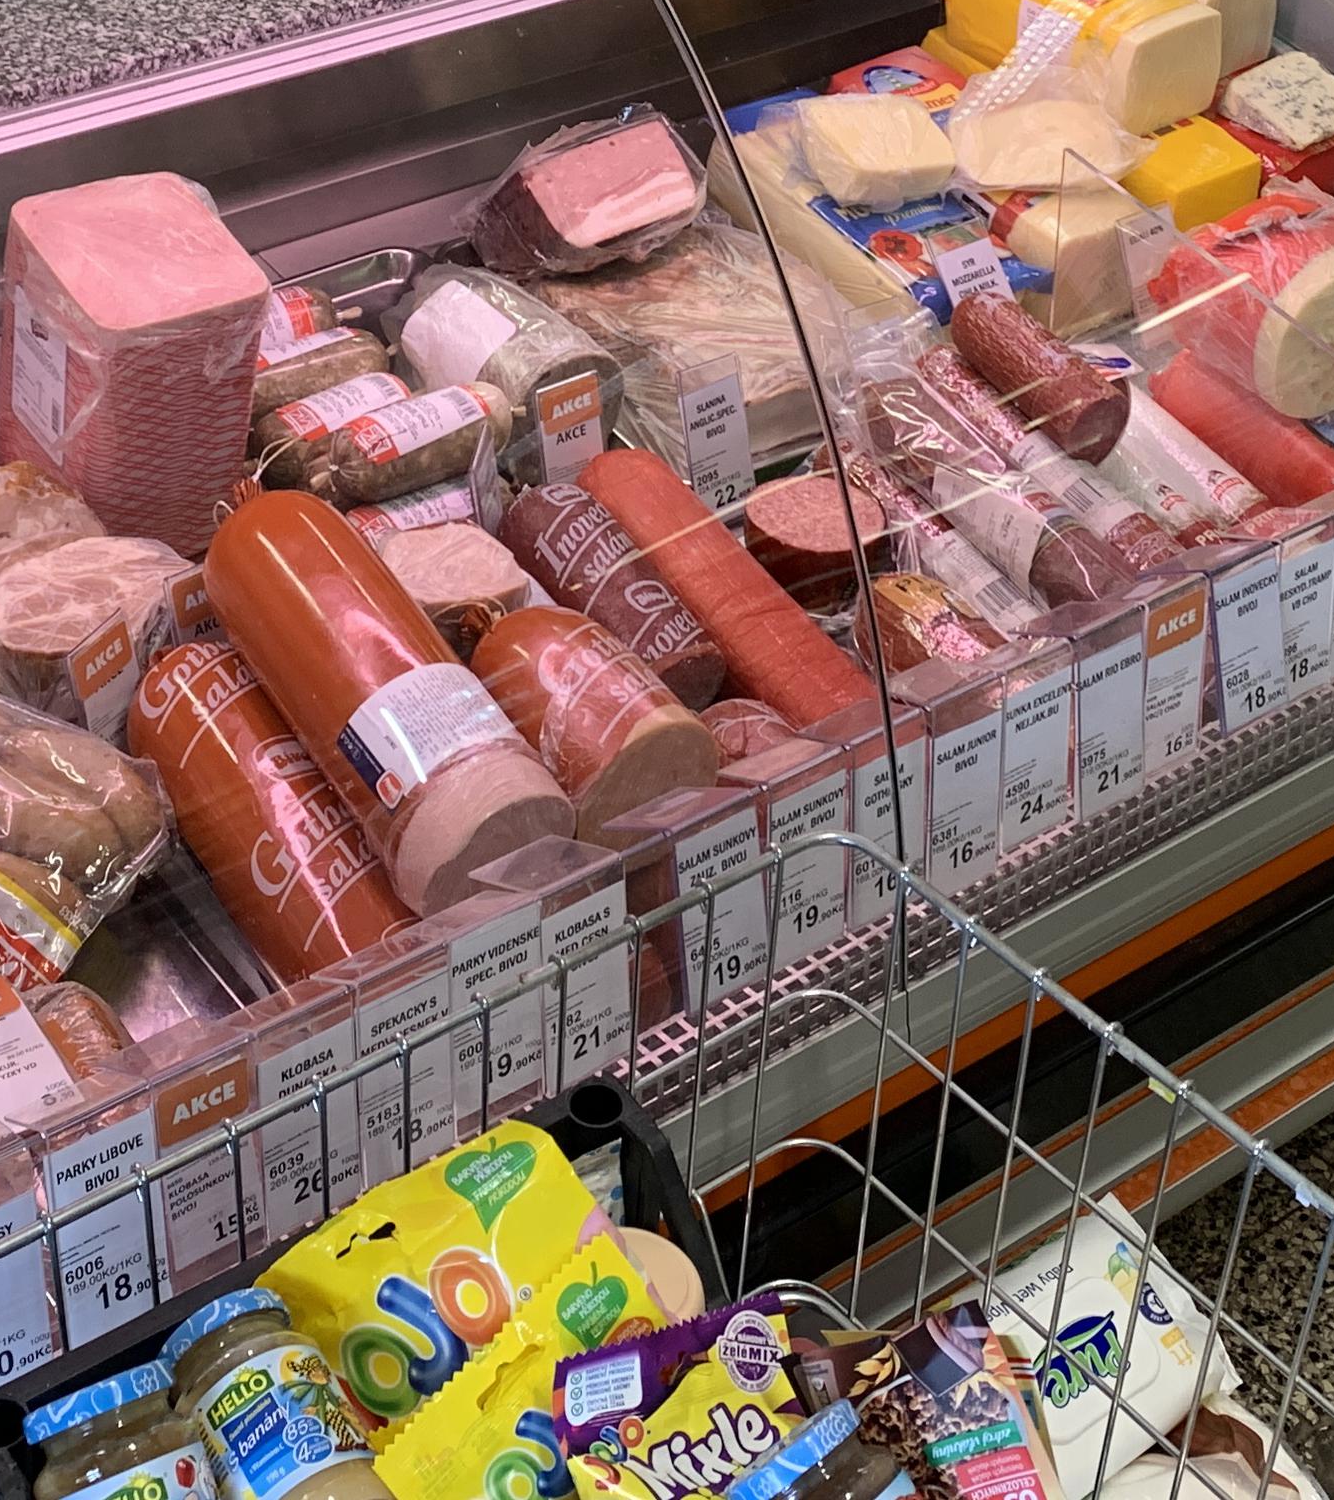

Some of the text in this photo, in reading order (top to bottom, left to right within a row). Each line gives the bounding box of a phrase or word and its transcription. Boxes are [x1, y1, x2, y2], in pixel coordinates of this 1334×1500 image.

[951, 263, 996, 289] MOZZARELLA
[551, 391, 592, 421] AKCE
[556, 424, 587, 445] AKCE
[714, 484, 736, 509] 22
[1156, 608, 1197, 640] AKCE
[966, 729, 997, 752] JUNIOR
[1097, 766, 1119, 794] 21
[811, 807, 835, 829] BIVOJ
[1019, 793, 1044, 824] 24
[713, 826, 756, 861] SUNKOVY
[721, 850, 748, 872] BIVOJ
[554, 912, 602, 945] KLOBASA
[792, 904, 819, 934] 19
[452, 926, 540, 978] PARKY VIDENSKE
[464, 949, 528, 990] SPEC. BIVOJ
[370, 1000, 428, 1038] SPEKACKY
[572, 1025, 601, 1061] 21
[280, 1048, 334, 1083] KLOBASA
[172, 1079, 237, 1125] AKCE
[366, 1102, 401, 1130] 5183
[55, 1133, 144, 1185] PARKY LIBOVE
[269, 1152, 304, 1180] 6039
[84, 1166, 119, 1193] BIVOJ
[65, 1255, 104, 1286] 6006
[98, 1272, 132, 1310] 18
[720, 1345, 780, 1364] želéMIX
[1040, 1328, 1130, 1409] Pure
[210, 1374, 267, 1425] HELLO
[238, 1401, 289, 1459] banány
[624, 1403, 777, 1500] Mixle
